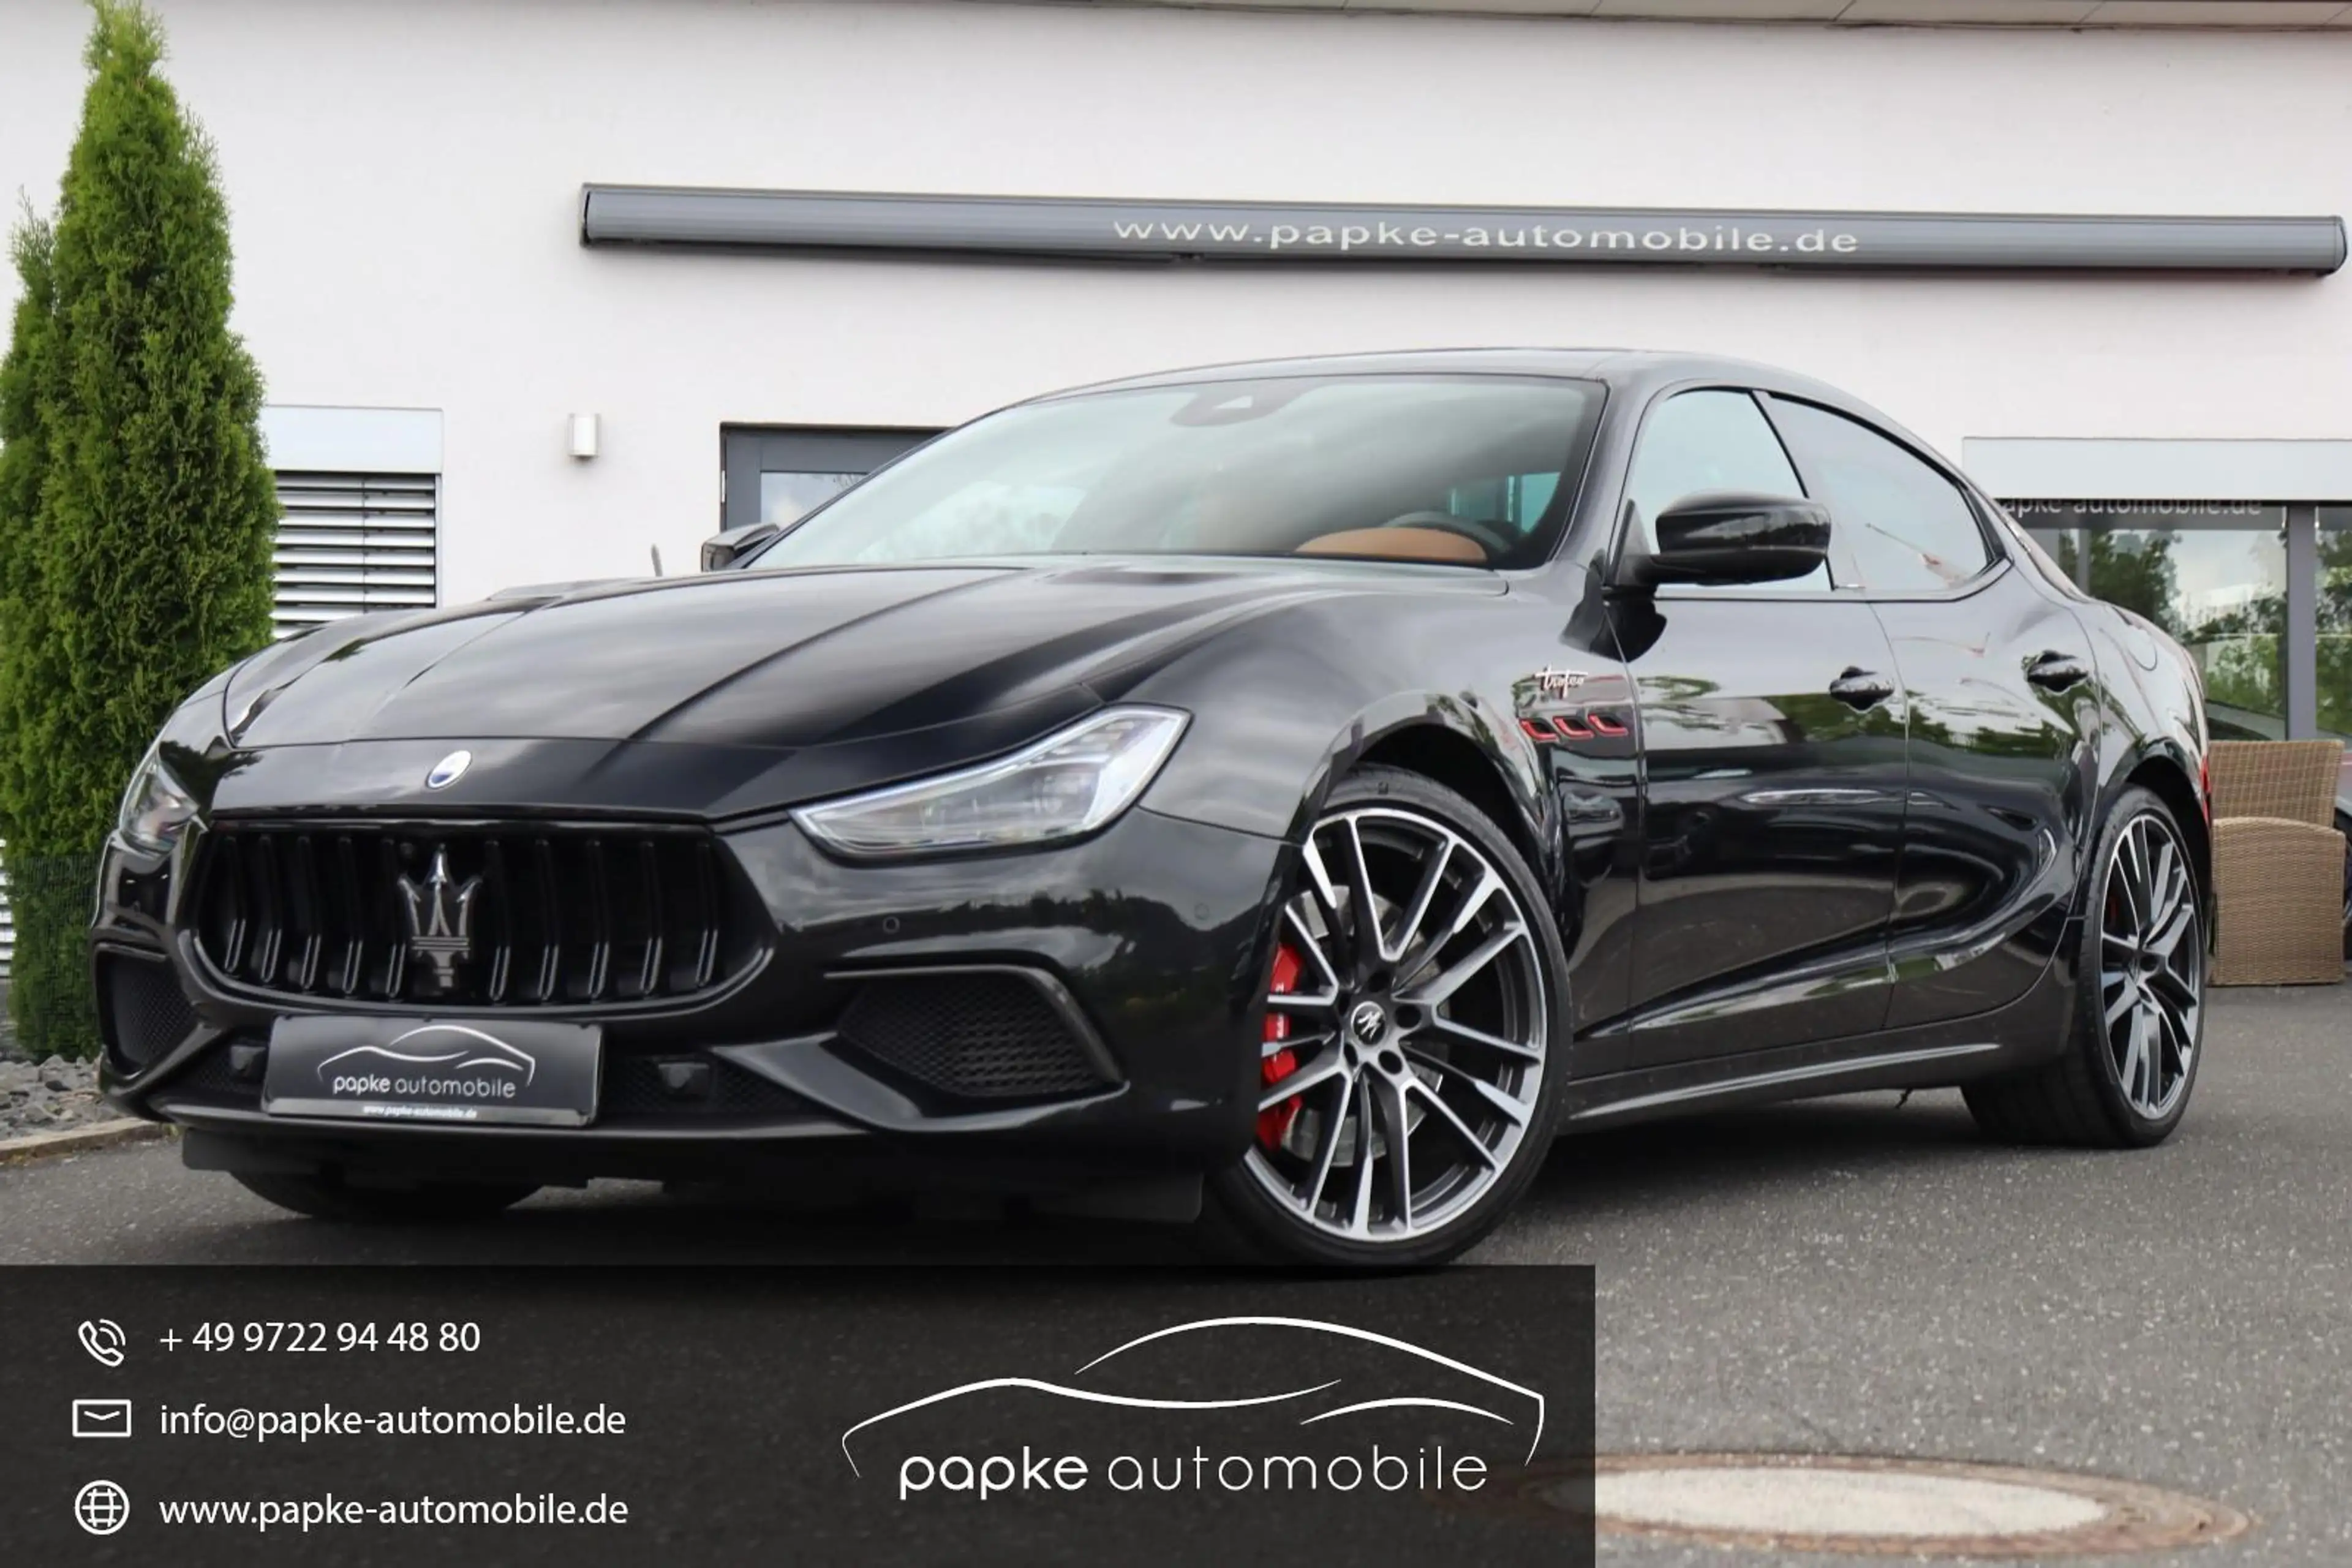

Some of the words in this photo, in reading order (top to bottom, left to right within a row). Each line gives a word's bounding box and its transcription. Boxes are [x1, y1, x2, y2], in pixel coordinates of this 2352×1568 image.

[1112, 218, 1860, 255] www.papke-automobile.de
[333, 1074, 391, 1095] papke
[394, 1076, 516, 1098] automobile
